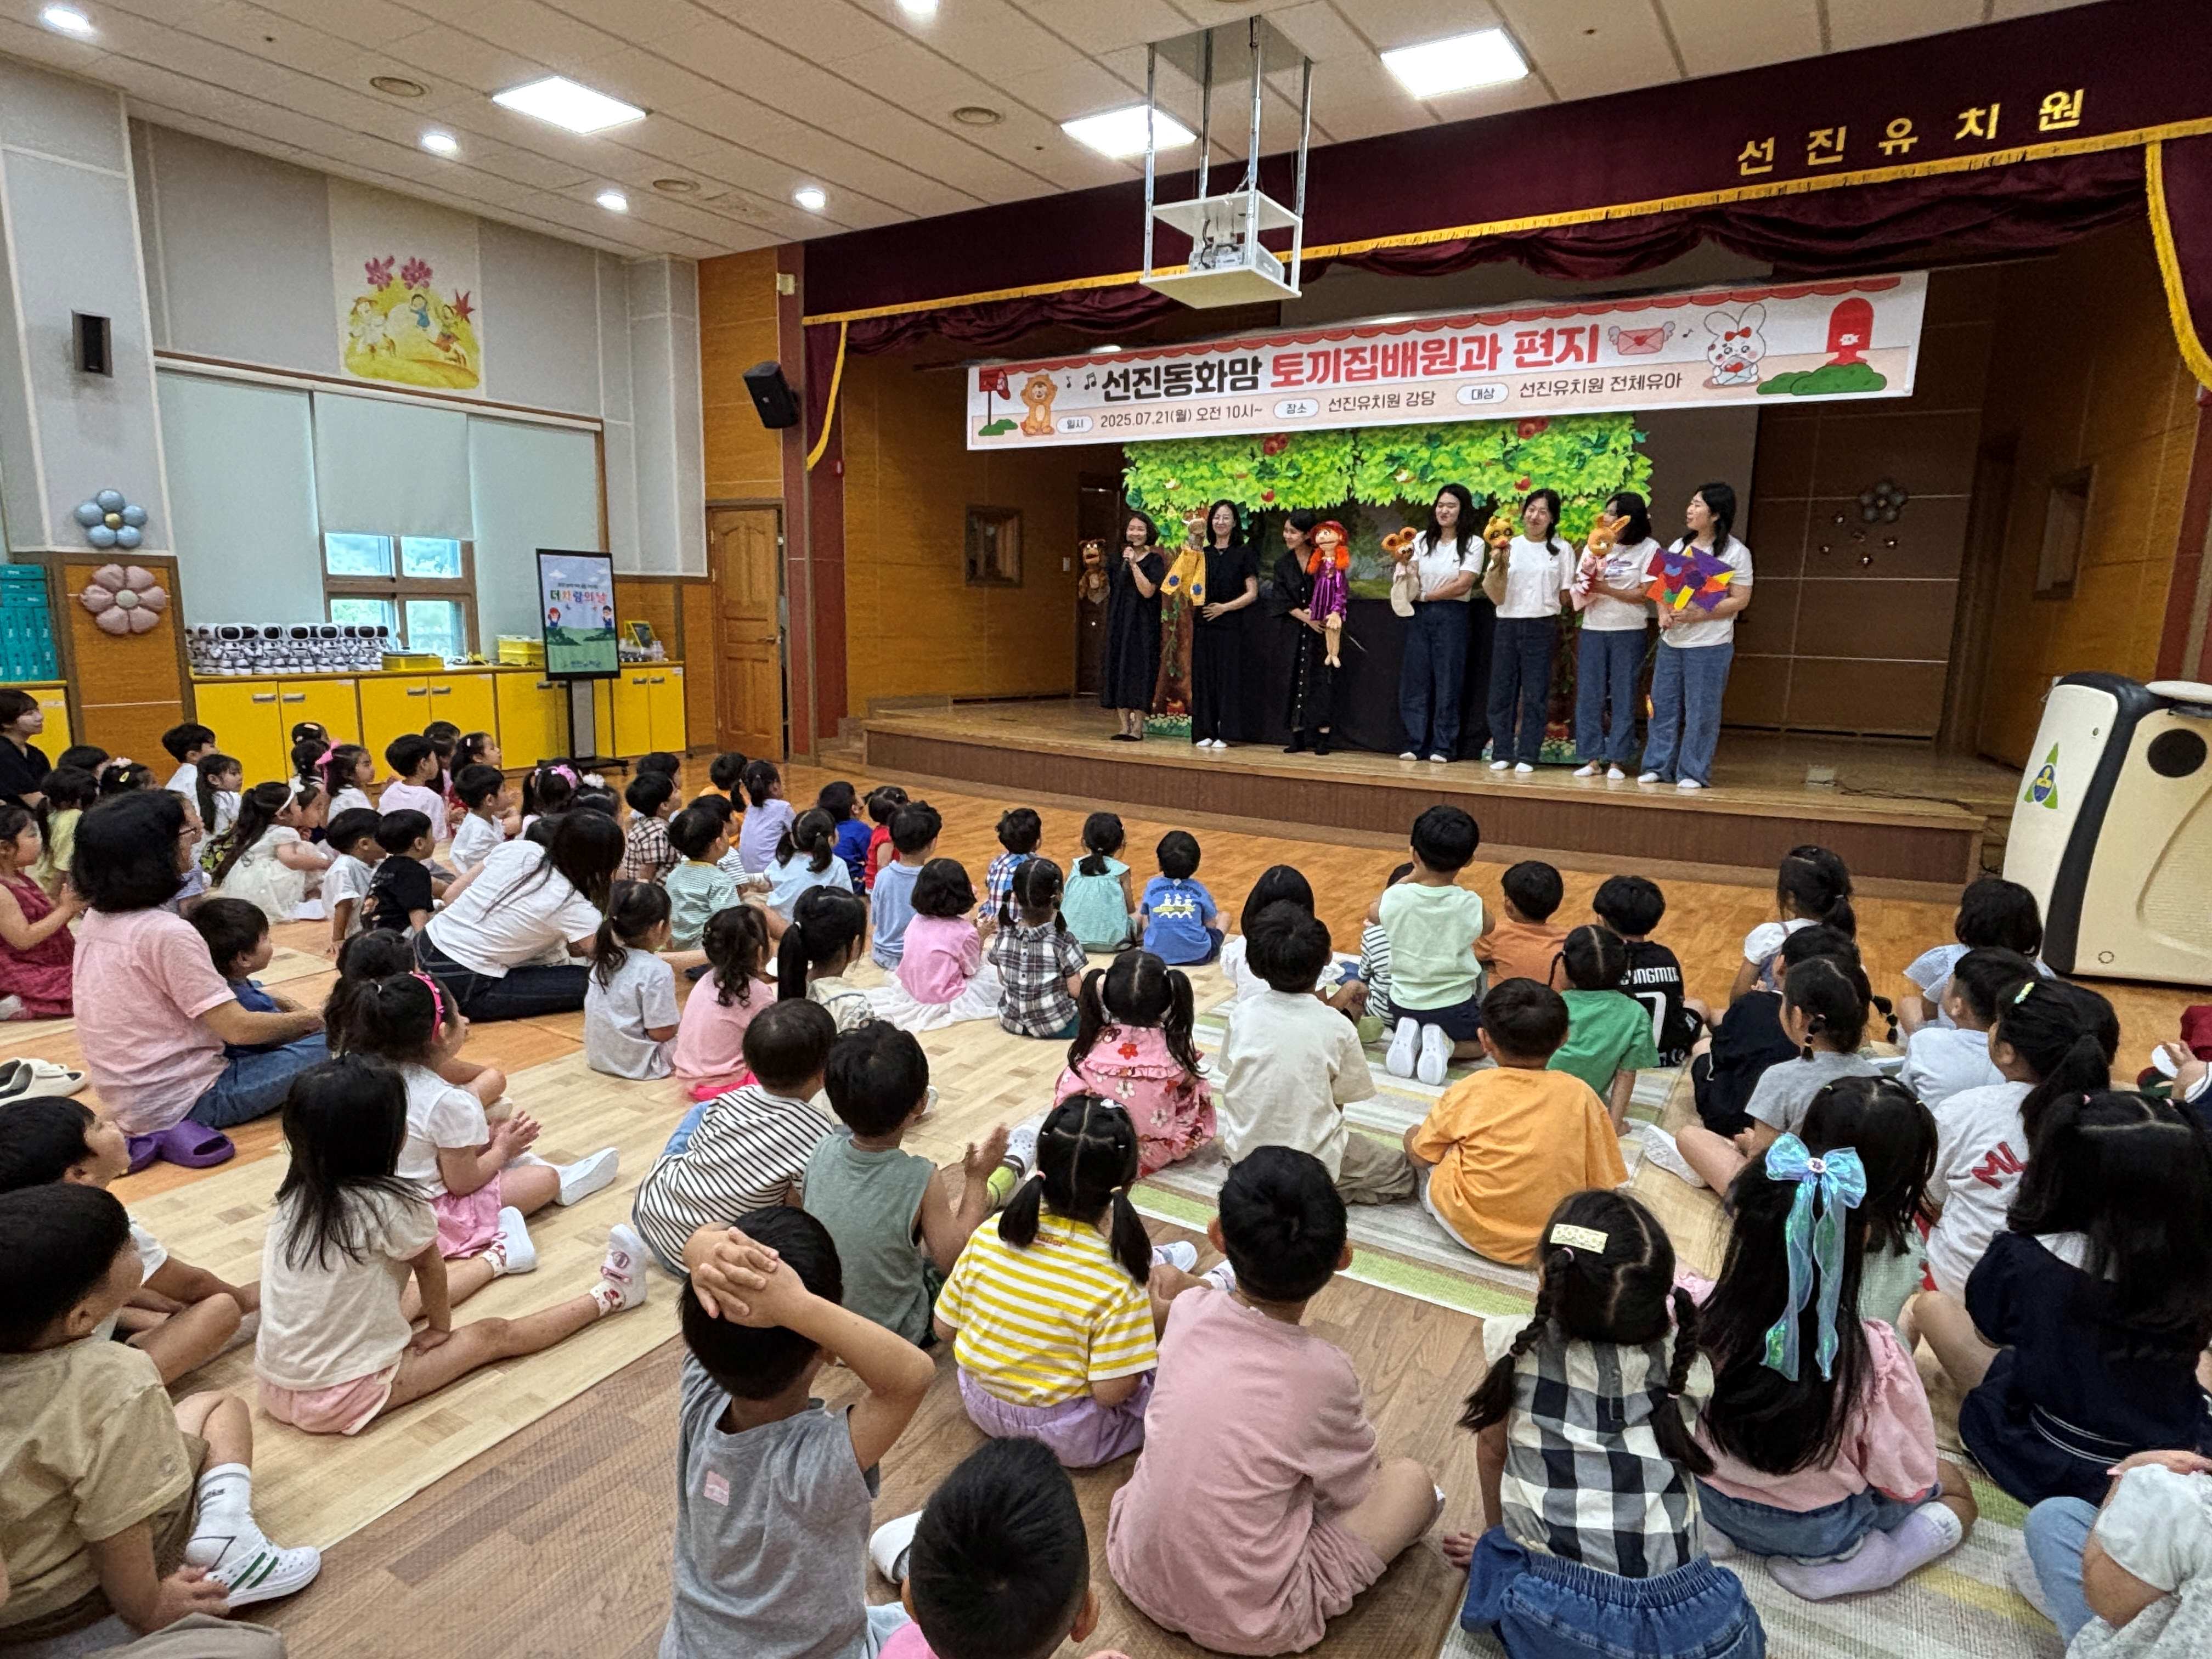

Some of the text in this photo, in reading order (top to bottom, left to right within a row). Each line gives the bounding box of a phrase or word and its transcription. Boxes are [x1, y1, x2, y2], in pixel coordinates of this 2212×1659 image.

[1102, 324, 1600, 402] 선진동화맘 토끼집배원과 편지
[1066, 372, 1683, 430] 일시 2025.07.21(월) 오전 10시~ 장소 선진유치원 강당 대상 선진유치원 전체유아
